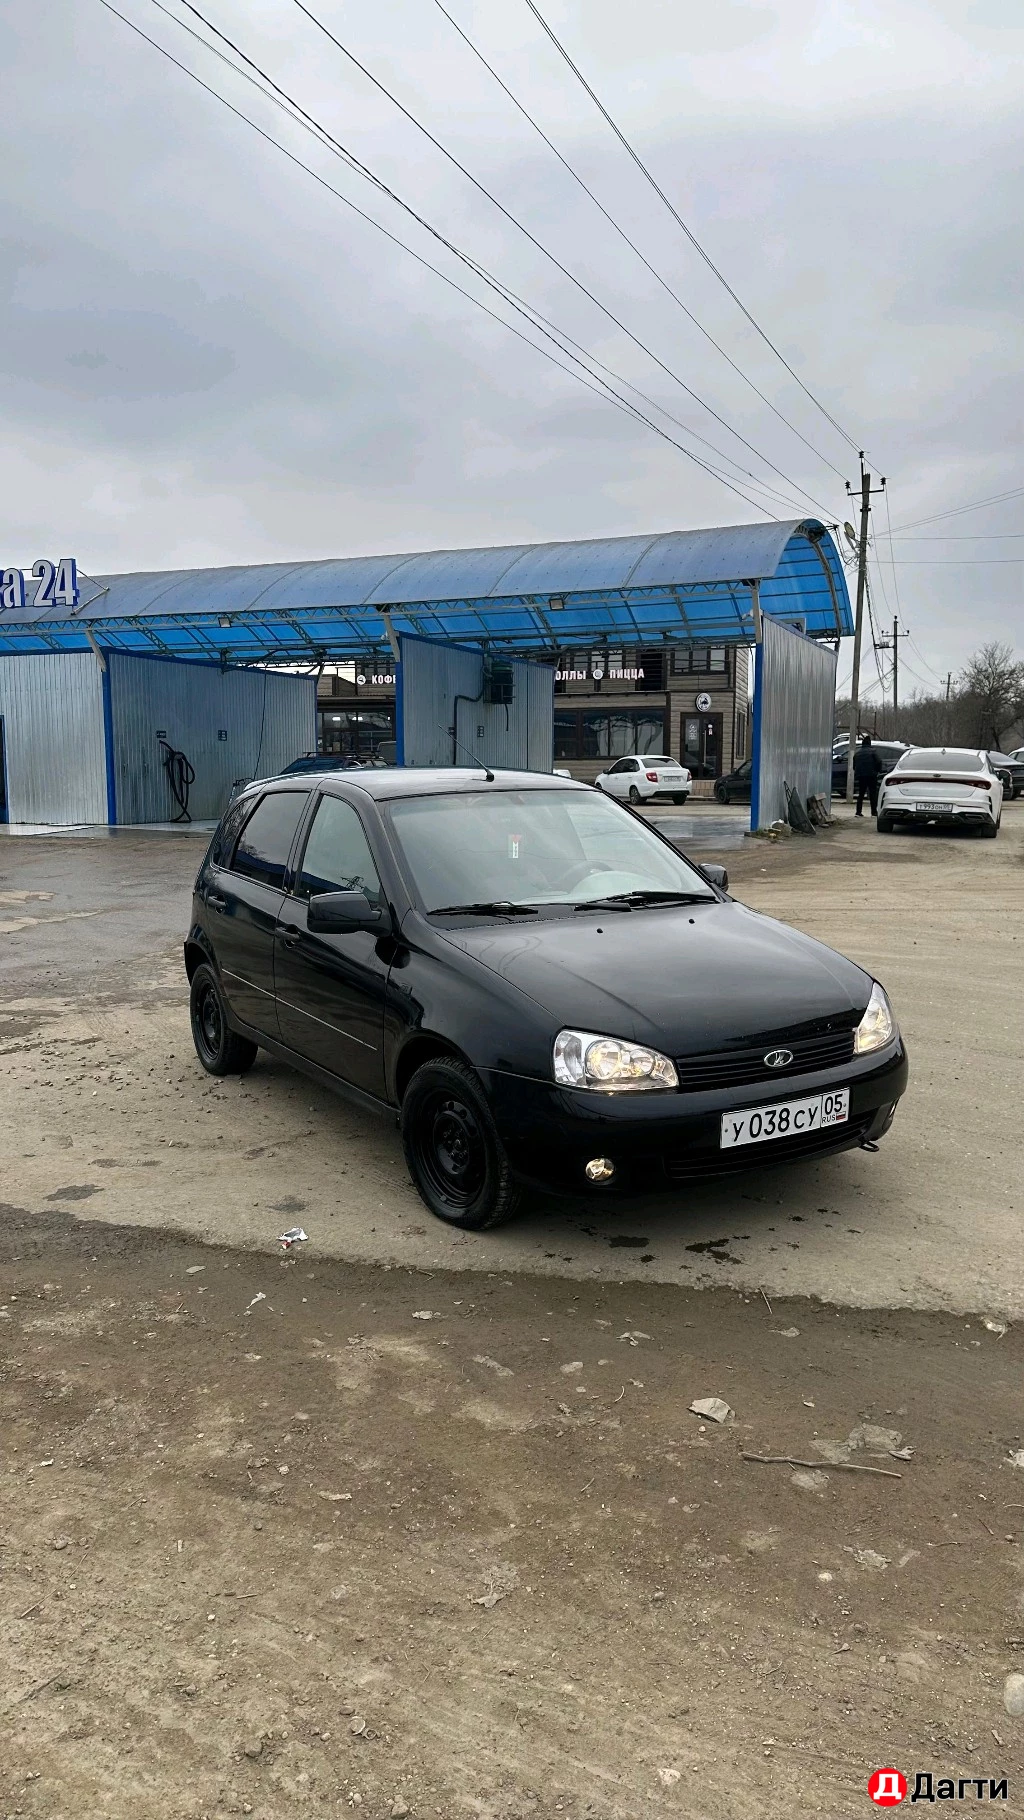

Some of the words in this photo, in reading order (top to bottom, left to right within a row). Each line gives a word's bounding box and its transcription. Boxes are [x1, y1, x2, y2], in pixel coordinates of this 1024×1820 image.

[0, 568, 25, 608] а
[32, 559, 79, 607] 24
[609, 668, 645, 680] ПИЦЦА
[824, 1093, 843, 1115] 05
[821, 1115, 836, 1124] RUS
